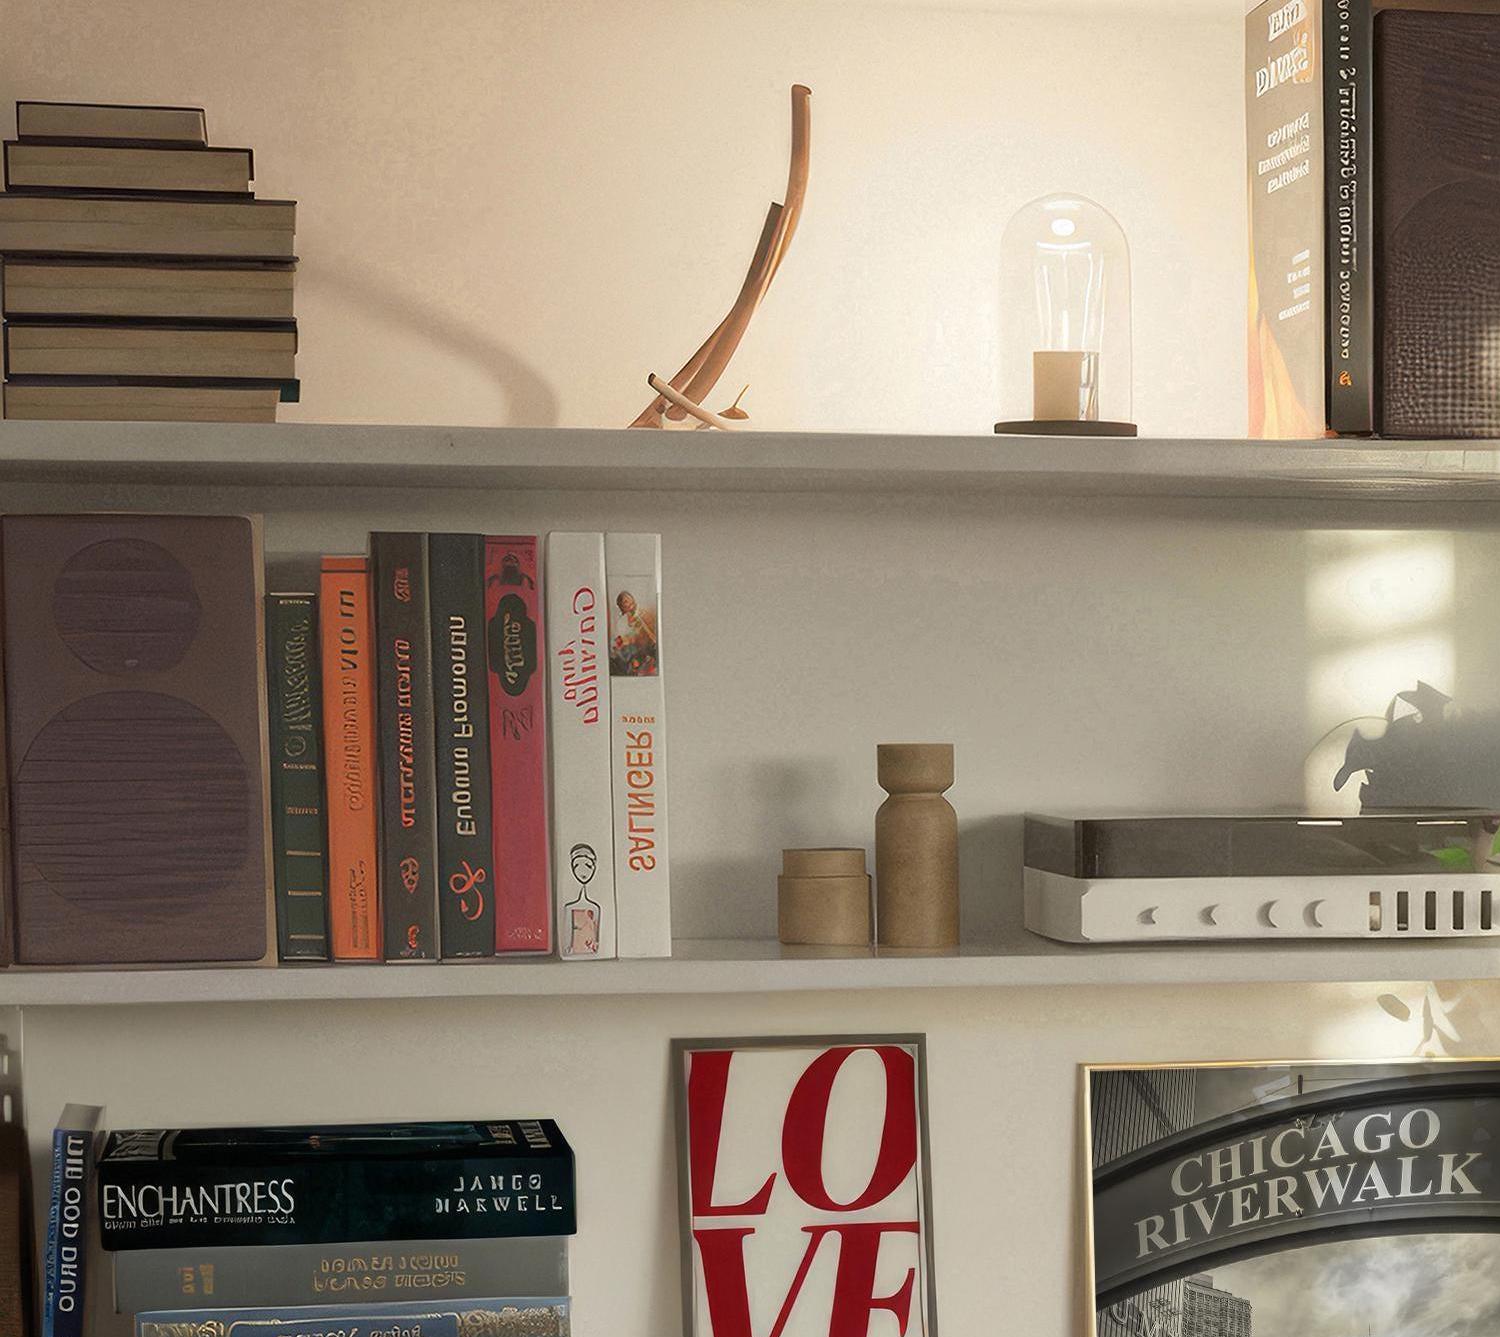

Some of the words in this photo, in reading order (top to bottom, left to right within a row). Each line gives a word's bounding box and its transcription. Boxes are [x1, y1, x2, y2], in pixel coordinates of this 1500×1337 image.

[1171, 1107, 1442, 1198] CHICAGO
[103, 1178, 296, 1219] ENCHANTRESS
[1134, 1152, 1483, 1259] RIVERWALK
